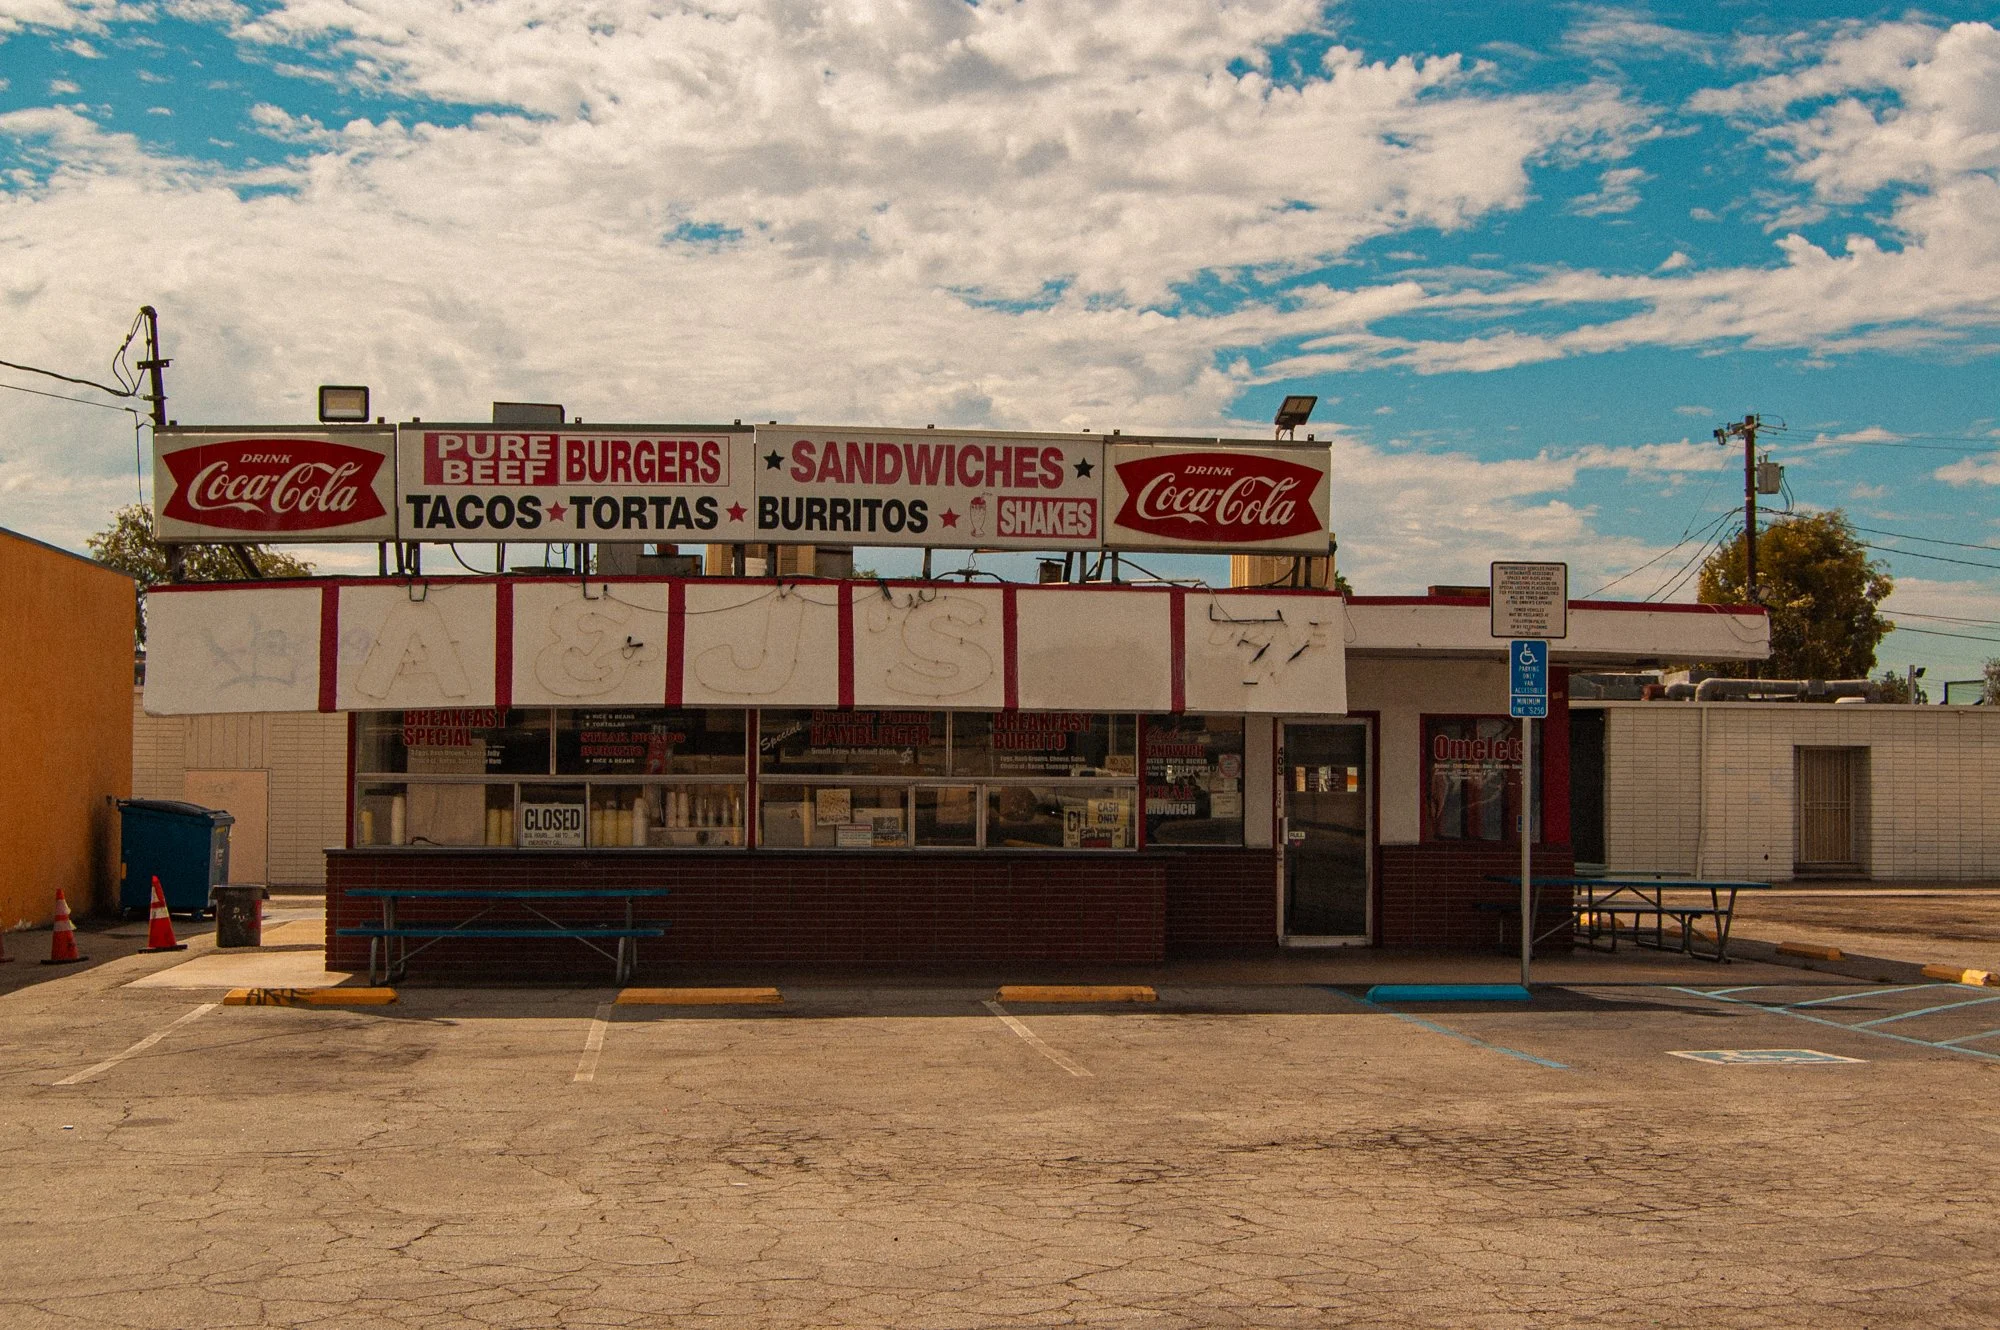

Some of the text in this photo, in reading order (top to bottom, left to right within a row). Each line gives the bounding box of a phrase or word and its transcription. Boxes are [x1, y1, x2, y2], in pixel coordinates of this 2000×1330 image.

[240, 453, 293, 465] DRINK
[437, 436, 553, 460] PURE
[440, 460, 547, 484] BEEF
[564, 439, 722, 484] BURGERS
[790, 440, 1065, 489] SANDWICHES
[1184, 465, 1234, 477] DRINK
[187, 461, 364, 514] Coca-Cola
[1136, 473, 1302, 526] Coca-Cola
[406, 494, 543, 530] TACOS
[569, 495, 719, 530] TORTAS
[758, 495, 929, 534] BURRITOS
[1000, 500, 1093, 537] SHAKES
[403, 708, 507, 729] BREAKFAST
[1512, 706, 1525, 714] FINE
[993, 711, 1093, 732] BREAKFAST
[403, 727, 473, 747] SPECIAL
[580, 731, 629, 743] STEAK
[760, 721, 803, 752] Special
[810, 723, 931, 746] HAMBURGER
[992, 730, 1068, 751] BURRITO
[580, 745, 645, 757] BURRITO
[1146, 784, 1196, 800] TEAK
[1097, 801, 1120, 813] CASH
[1146, 801, 1196, 815] NDWICH
[525, 808, 580, 831] CLOSED
[1097, 813, 1119, 824] ONLY
